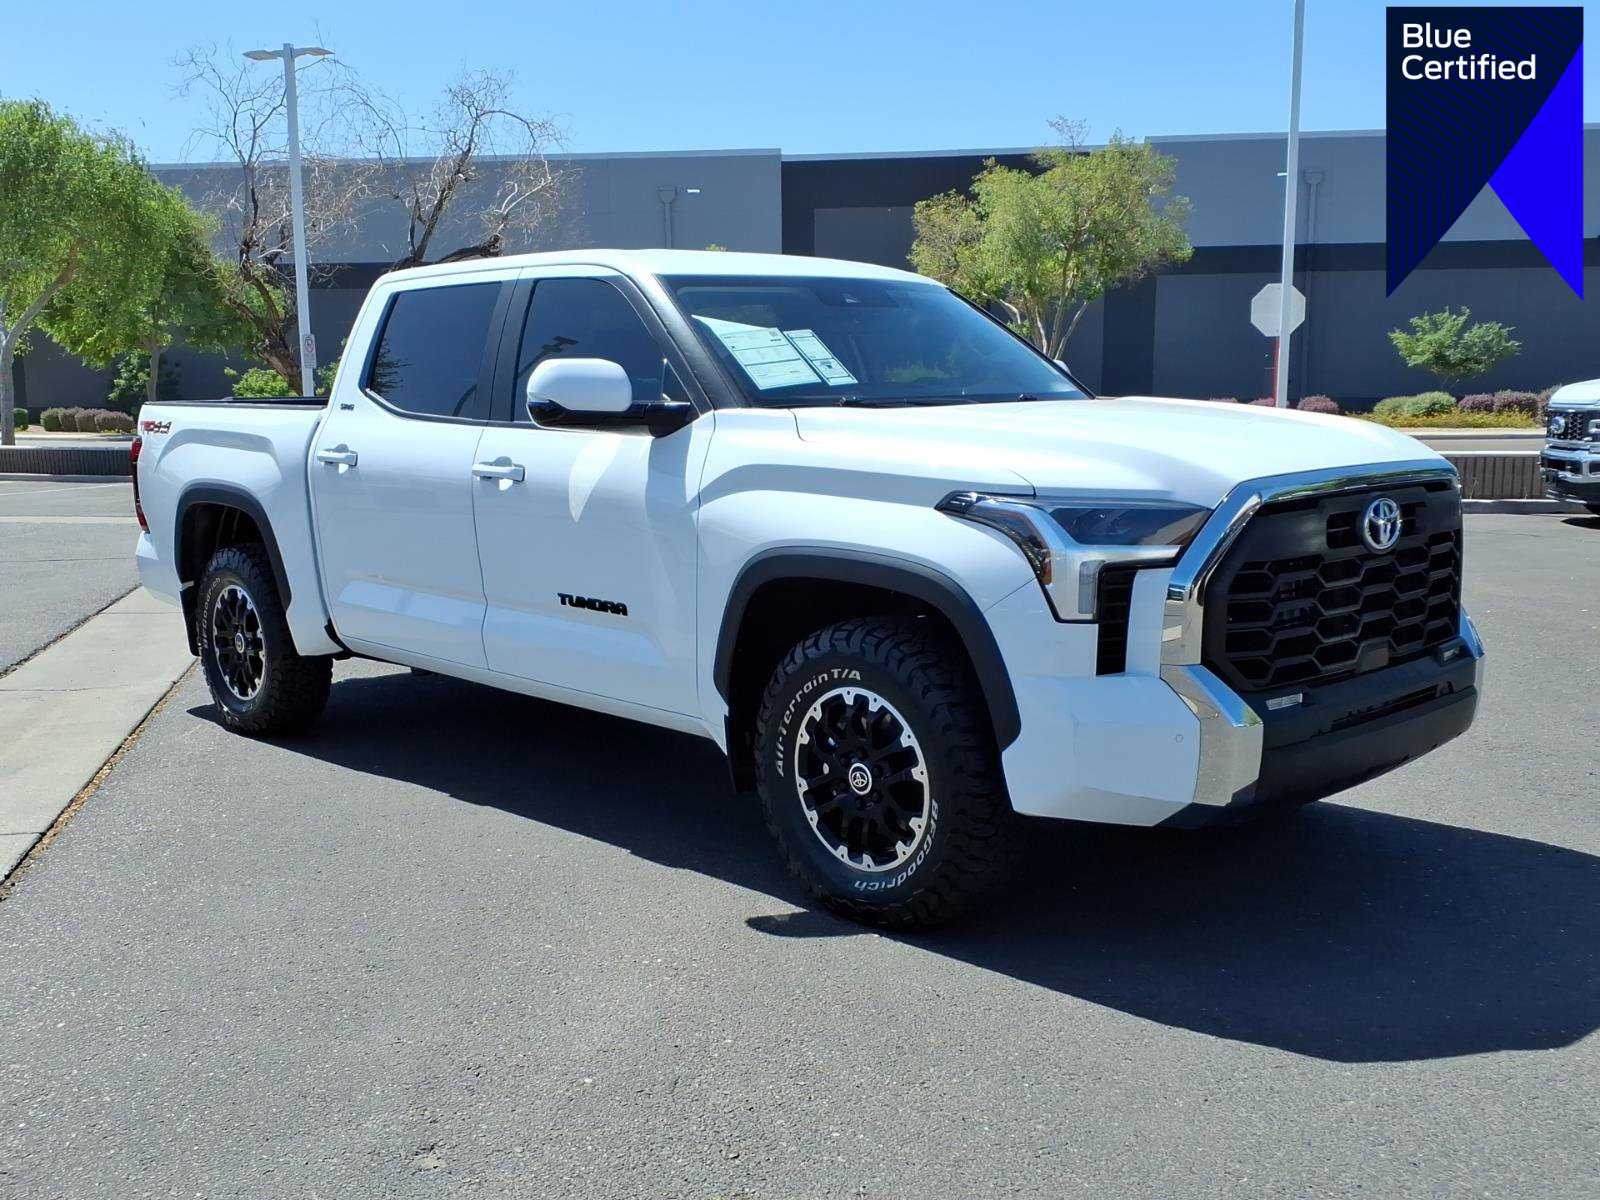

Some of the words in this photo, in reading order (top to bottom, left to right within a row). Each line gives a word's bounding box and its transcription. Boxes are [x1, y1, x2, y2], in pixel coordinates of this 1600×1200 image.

[557, 592, 628, 616] TUNDRA
[776, 673, 828, 777] All-Terrain
[830, 668, 862, 681] T/A
[854, 799, 939, 892] BFGoodrich
